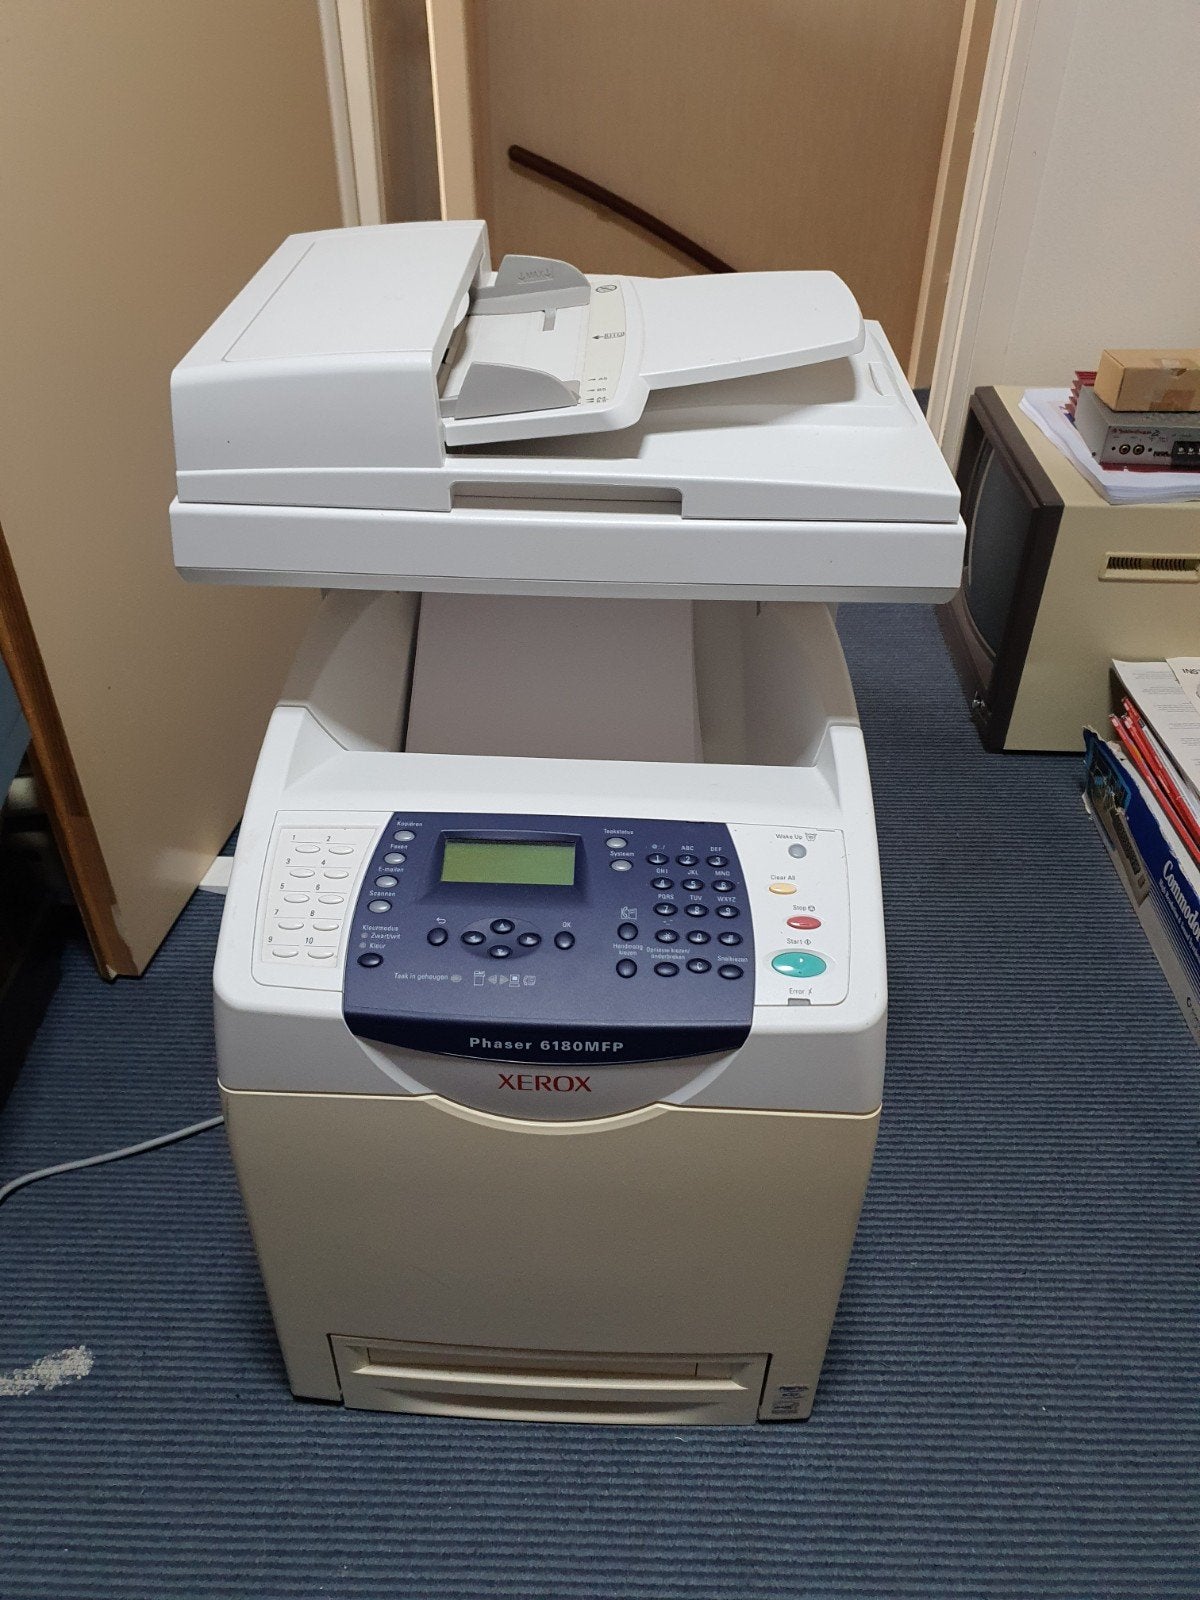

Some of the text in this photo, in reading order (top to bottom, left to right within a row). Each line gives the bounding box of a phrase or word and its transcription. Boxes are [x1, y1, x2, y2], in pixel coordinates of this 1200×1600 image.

[1163, 859, 1200, 942] Commodor
[469, 1037, 624, 1052] Phaser 6180MFP
[498, 1073, 592, 1093] XEROX
